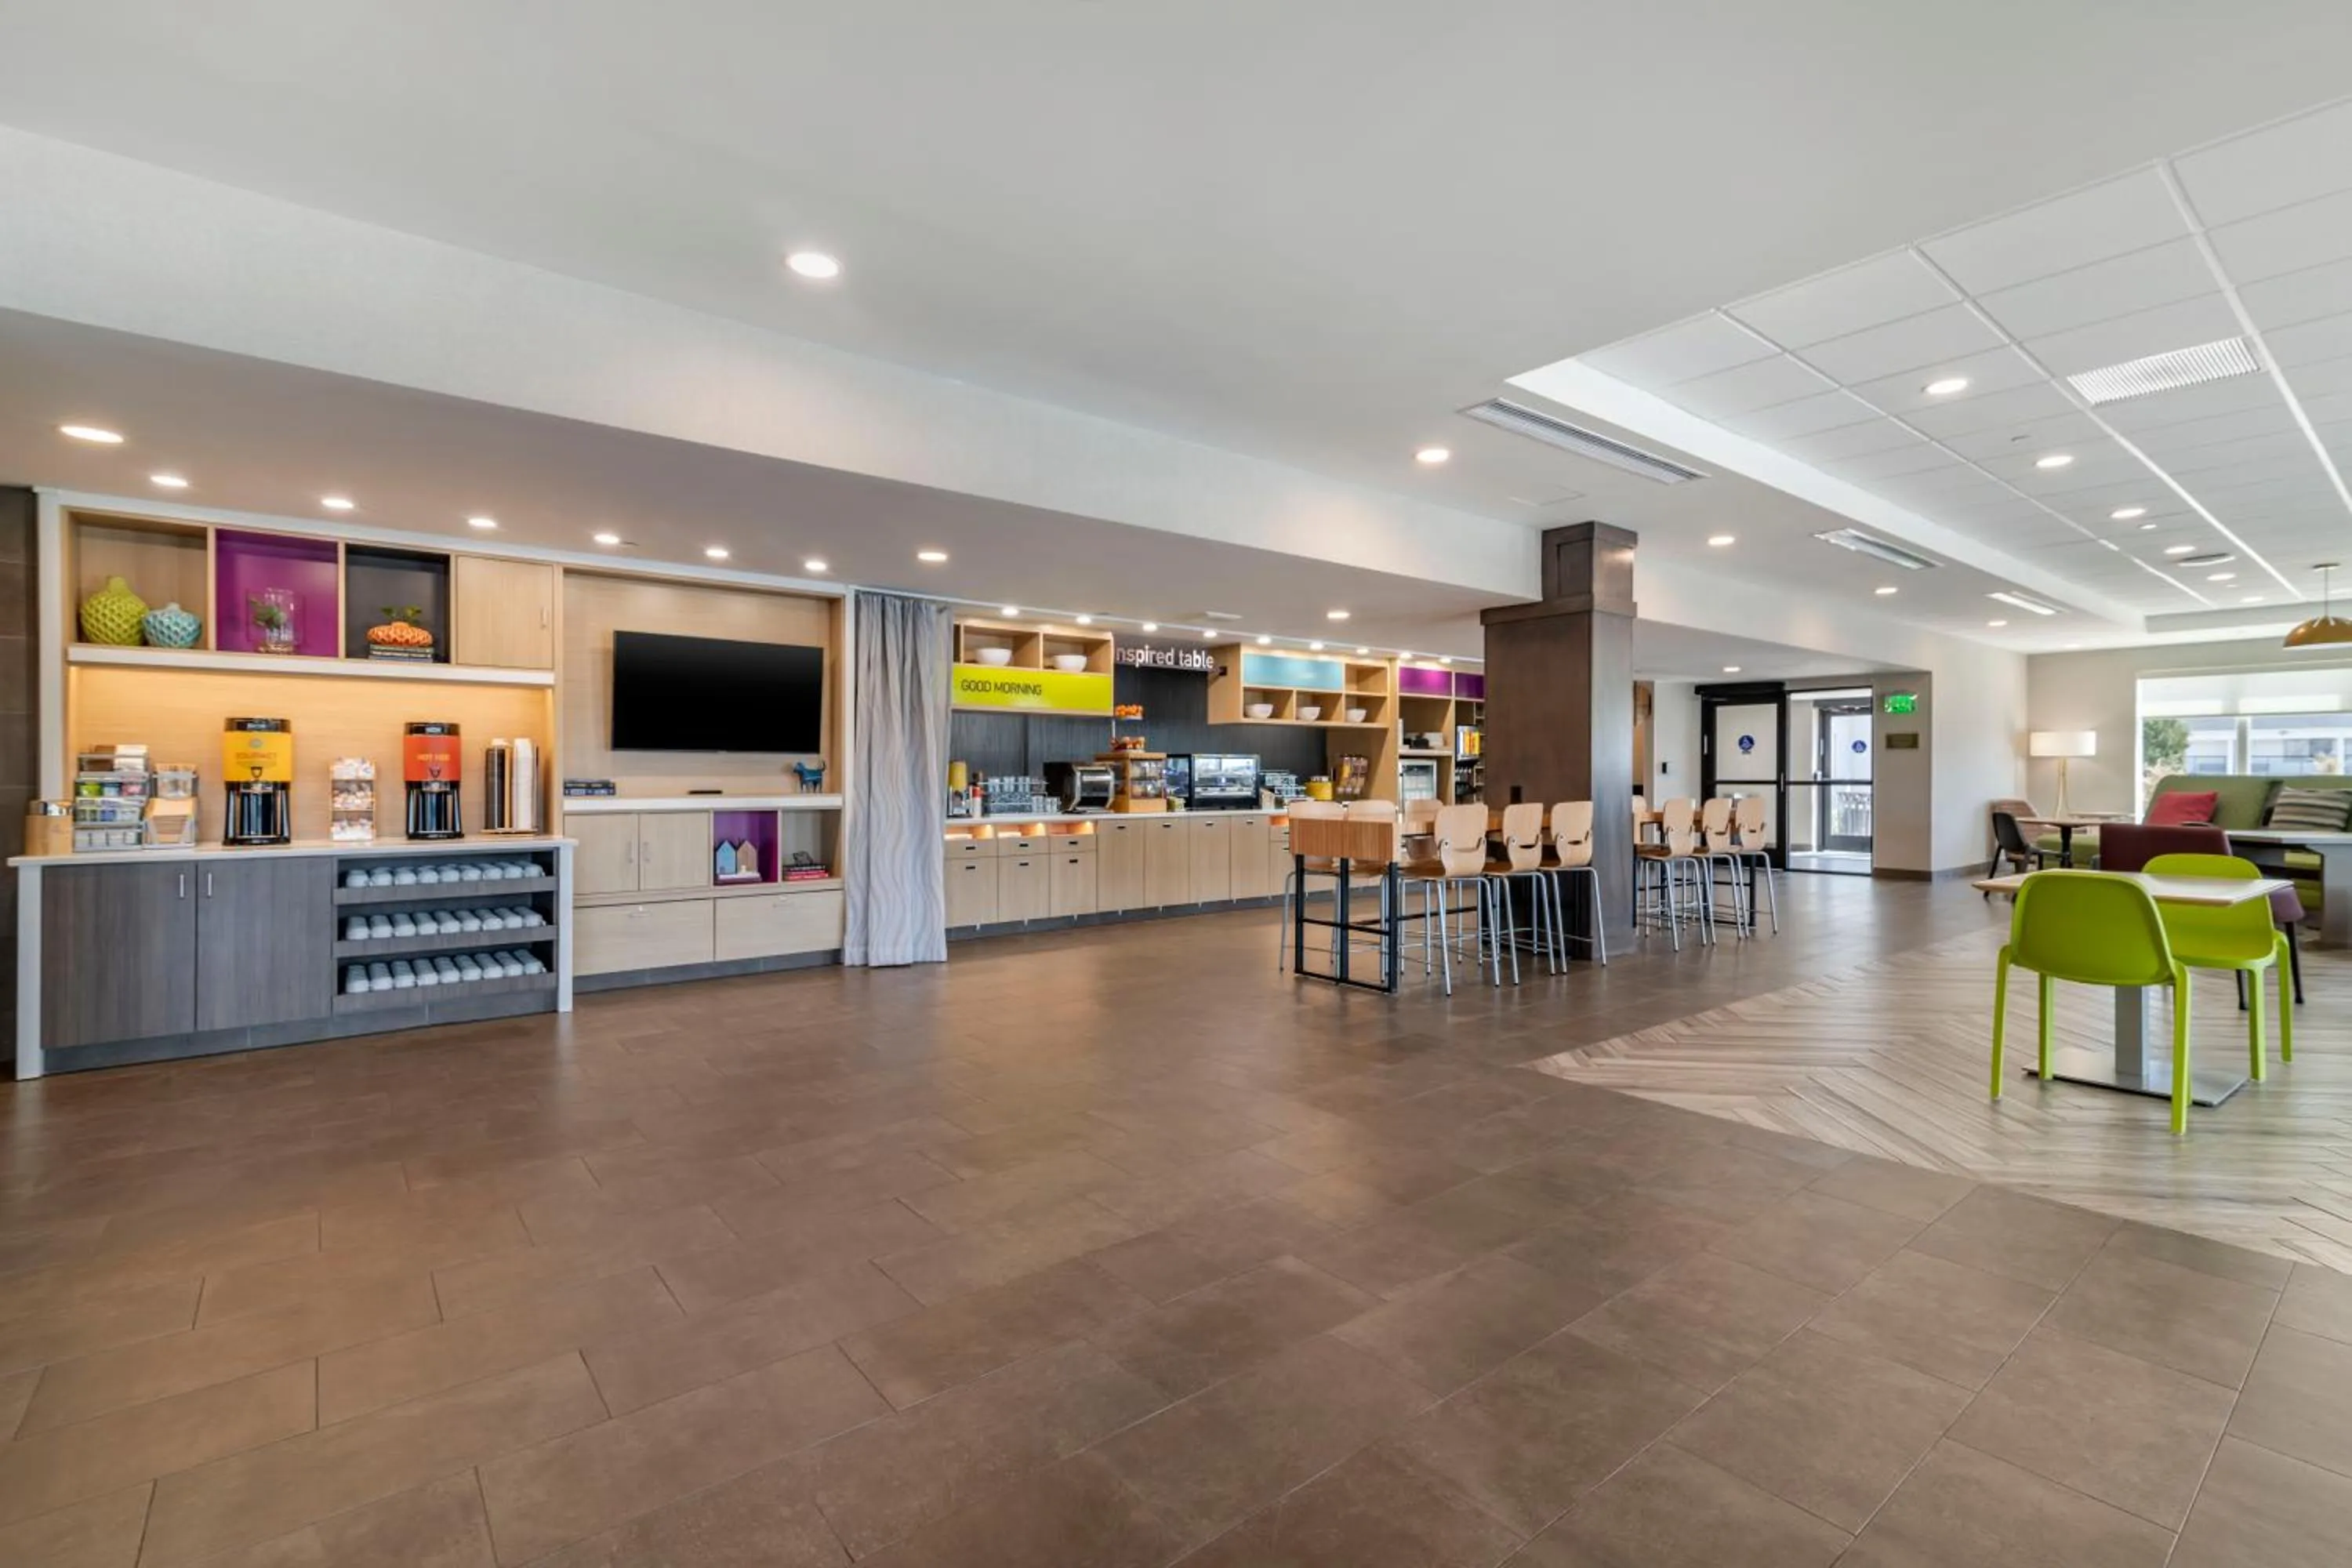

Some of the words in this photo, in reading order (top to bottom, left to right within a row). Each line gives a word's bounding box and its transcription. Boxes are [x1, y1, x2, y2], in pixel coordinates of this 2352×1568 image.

[1116, 644, 1174, 668] nspired
[1178, 648, 1214, 669] table
[960, 679, 992, 692] GOOD
[993, 681, 1043, 695] MORNING
